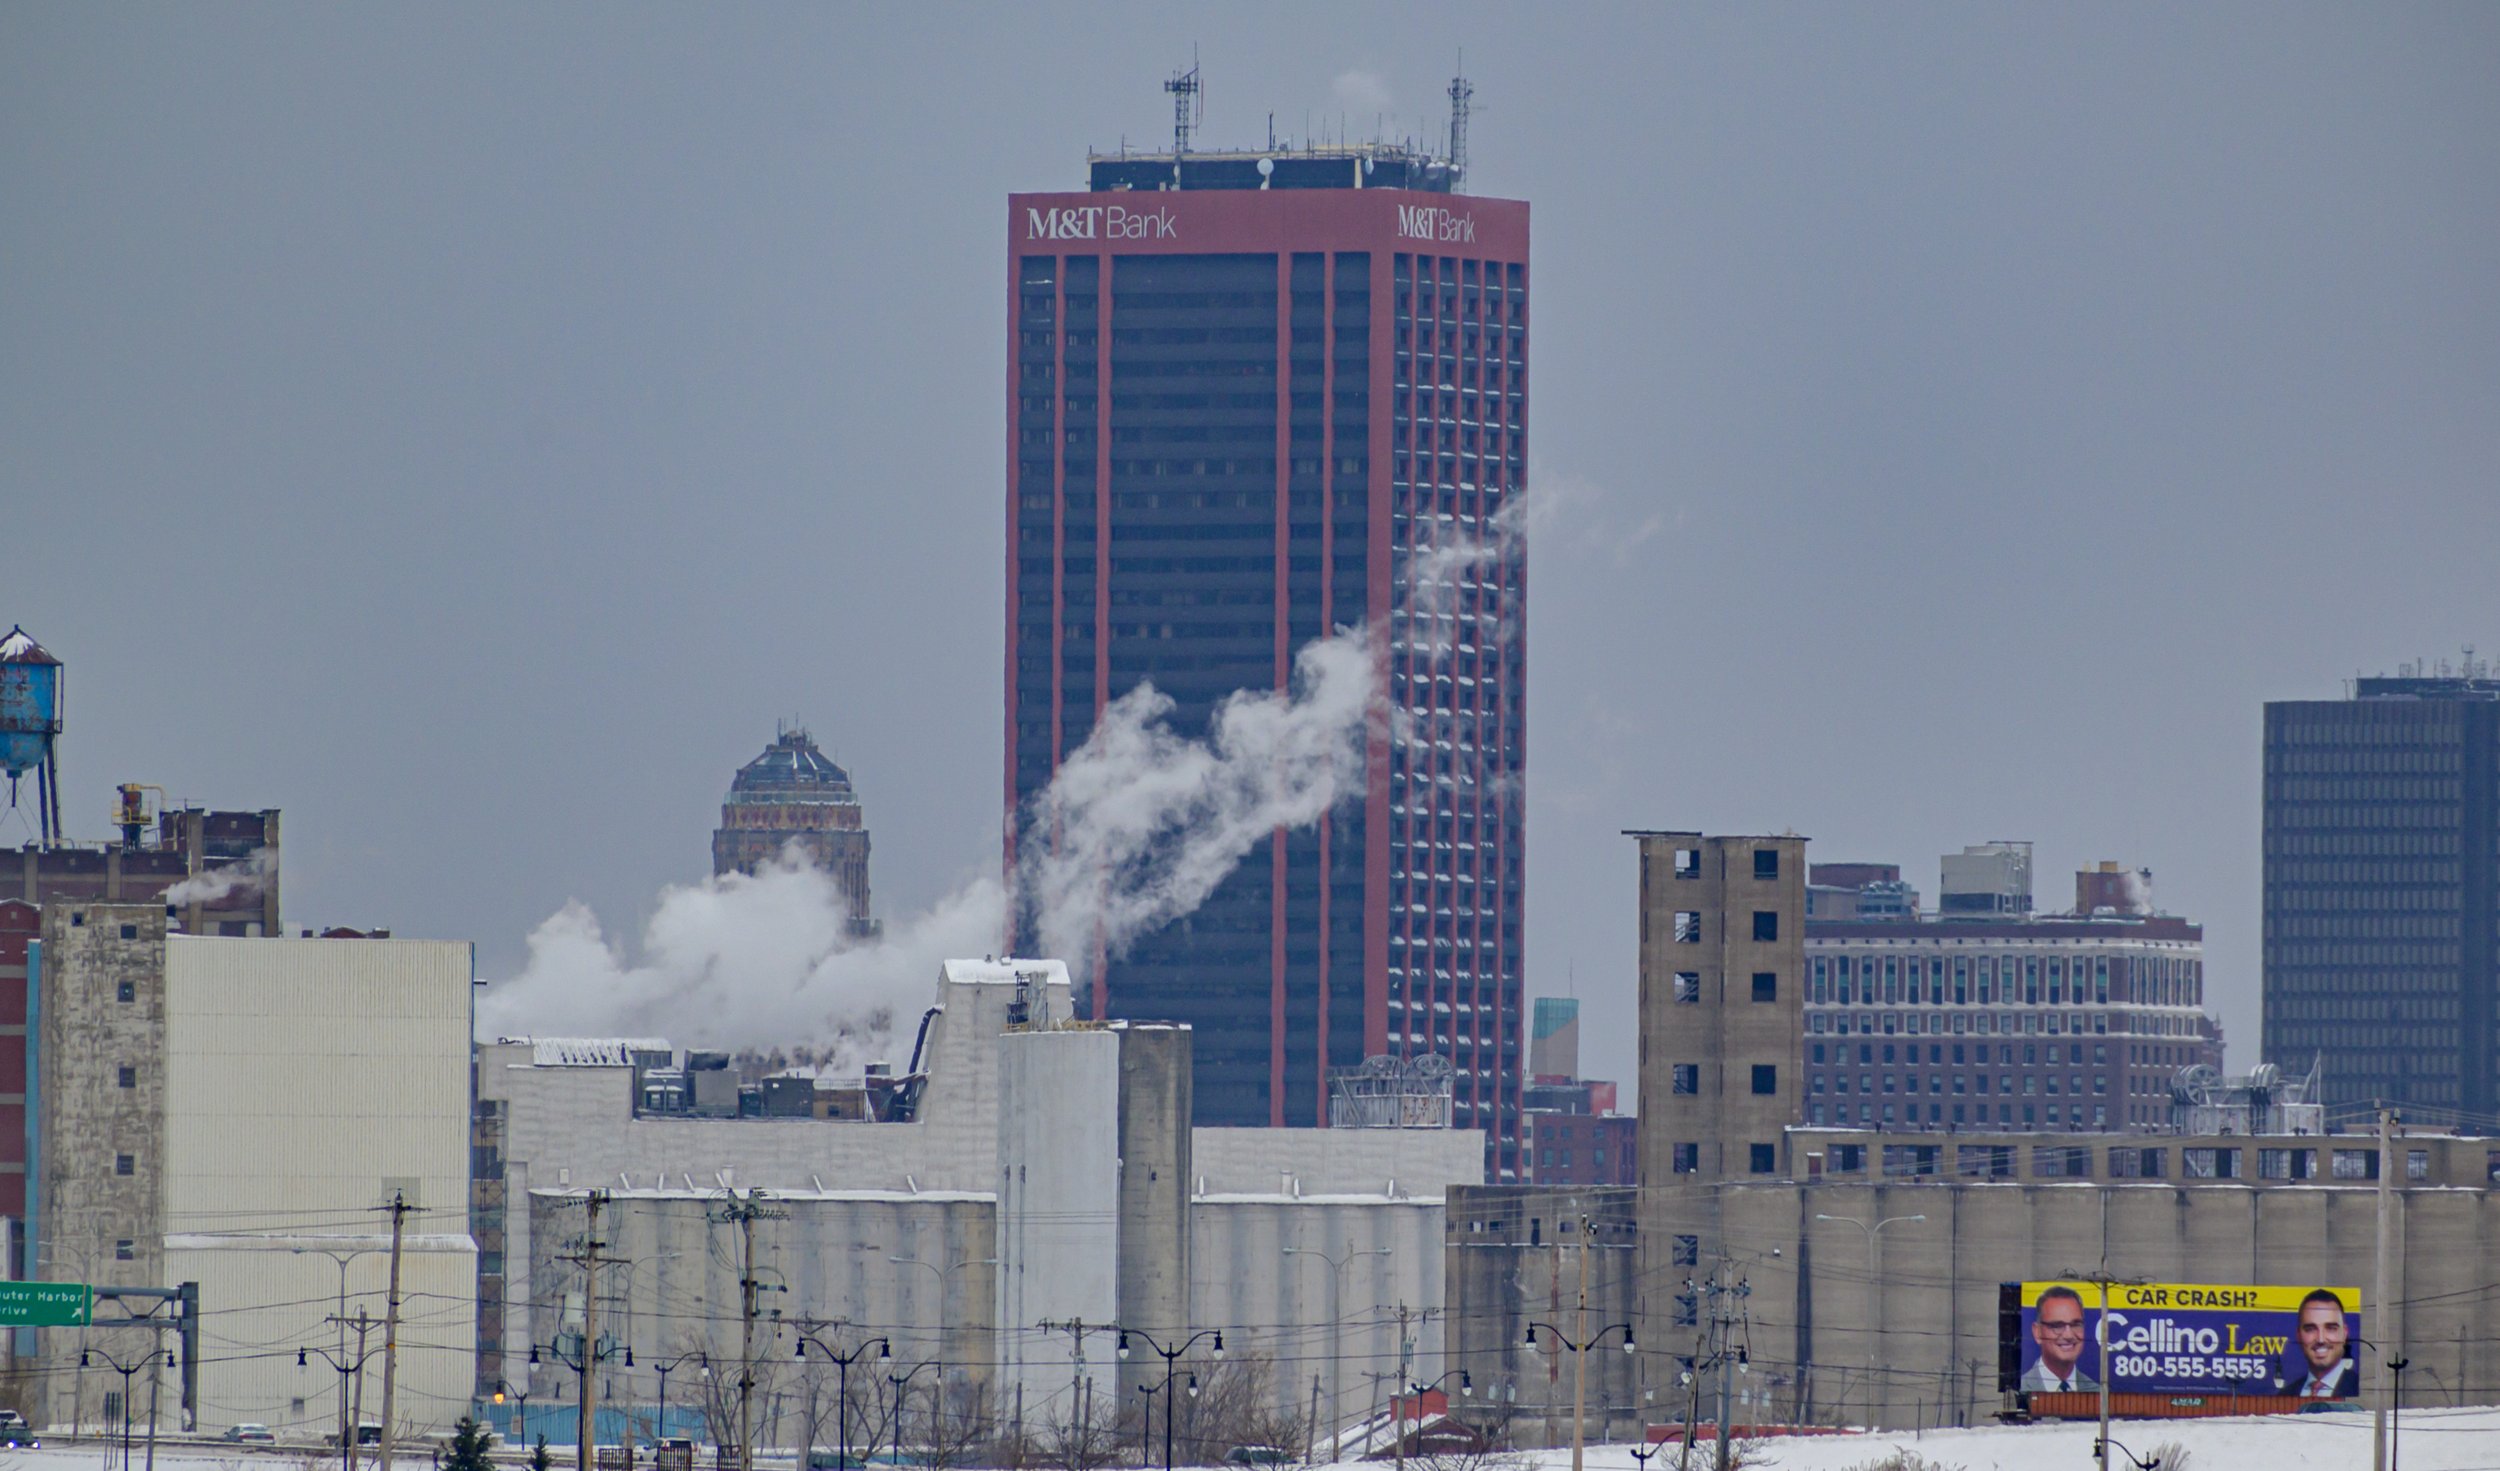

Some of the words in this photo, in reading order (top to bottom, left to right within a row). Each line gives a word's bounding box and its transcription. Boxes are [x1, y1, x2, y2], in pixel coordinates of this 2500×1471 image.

[1026, 206, 1103, 240] M&T
[1106, 205, 1177, 240] Bank
[1397, 204, 1438, 240] M&T
[1439, 208, 1476, 244] Bank
[0, 1290, 30, 1301] uter
[37, 1291, 83, 1302] Harbor
[2126, 1289, 2168, 1305] CAR
[2176, 1289, 2258, 1307] CRASH?
[0, 1305, 27, 1316] rive
[2095, 1313, 2219, 1354] Cellino
[2225, 1324, 2288, 1355] Law
[2115, 1355, 2267, 1379] 800-555-5555
